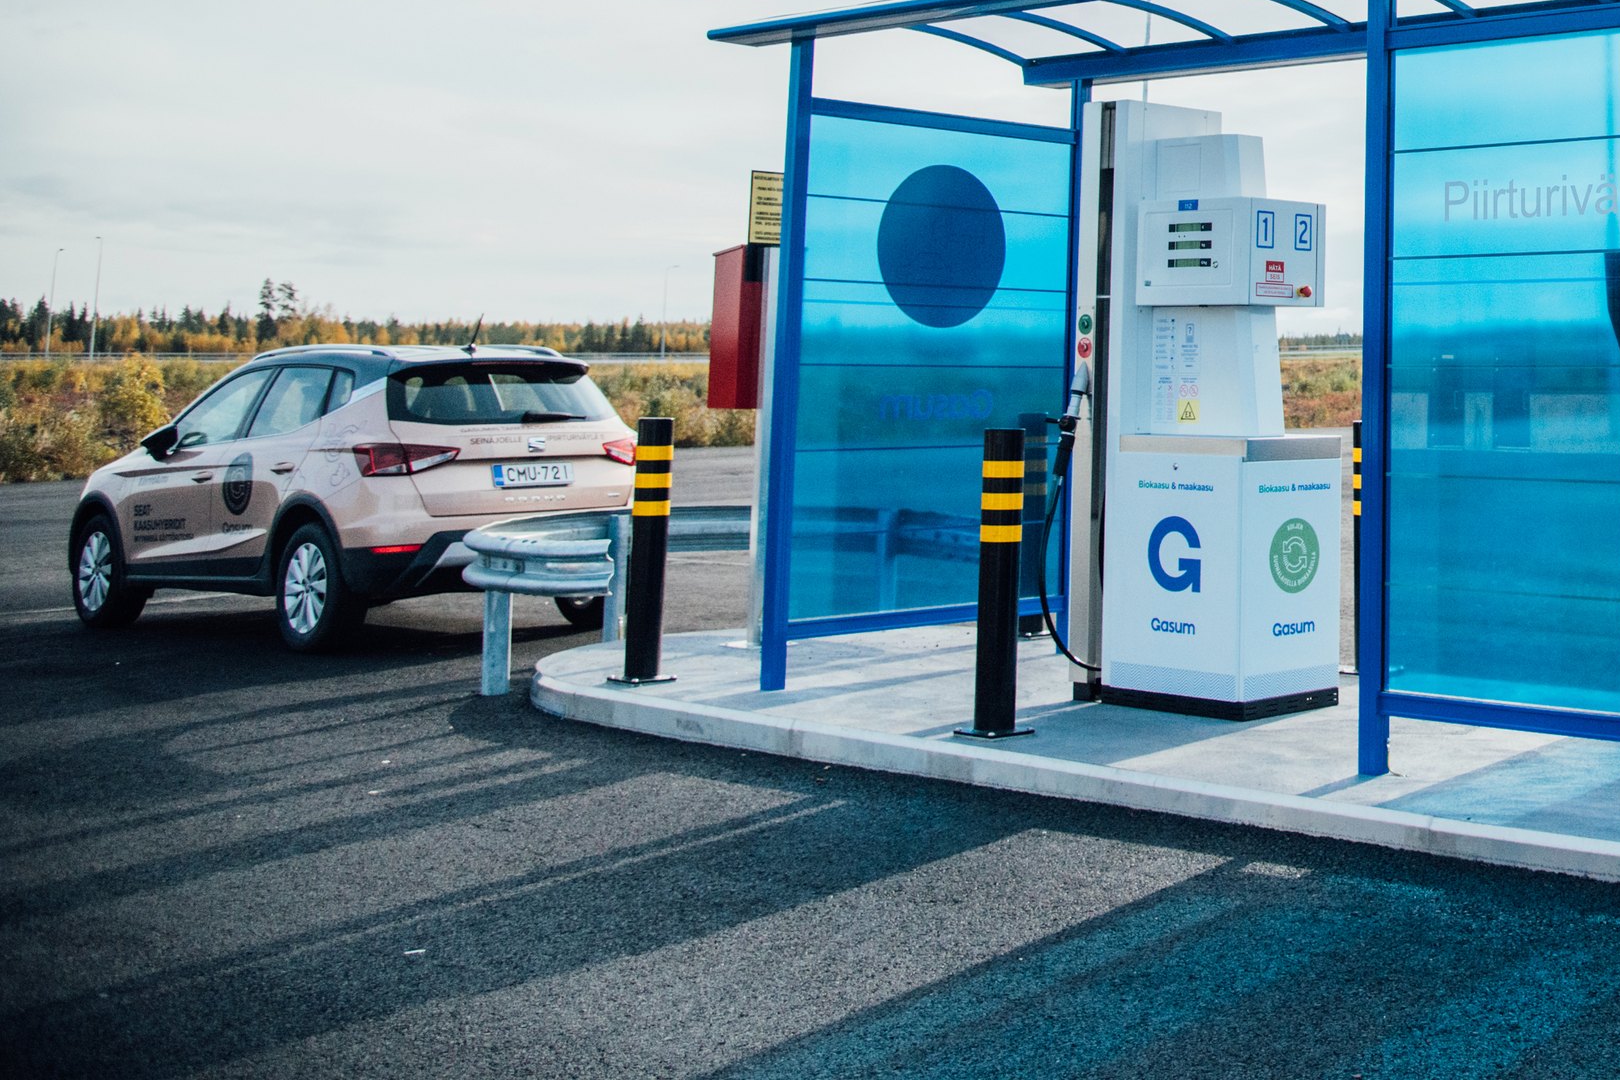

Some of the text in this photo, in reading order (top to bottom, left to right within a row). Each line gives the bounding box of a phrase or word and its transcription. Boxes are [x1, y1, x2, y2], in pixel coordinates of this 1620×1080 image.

[1262, 217, 1268, 241] 1
[1299, 220, 1308, 244] 2
[1138, 480, 1169, 489] Biokaasu
[1178, 483, 1213, 492] maakaasu
[1259, 482, 1330, 493] Biokaasu & maakaasu
[1148, 516, 1201, 593] G
[1151, 617, 1195, 635] Gasum
[1272, 620, 1315, 636] Gasum
